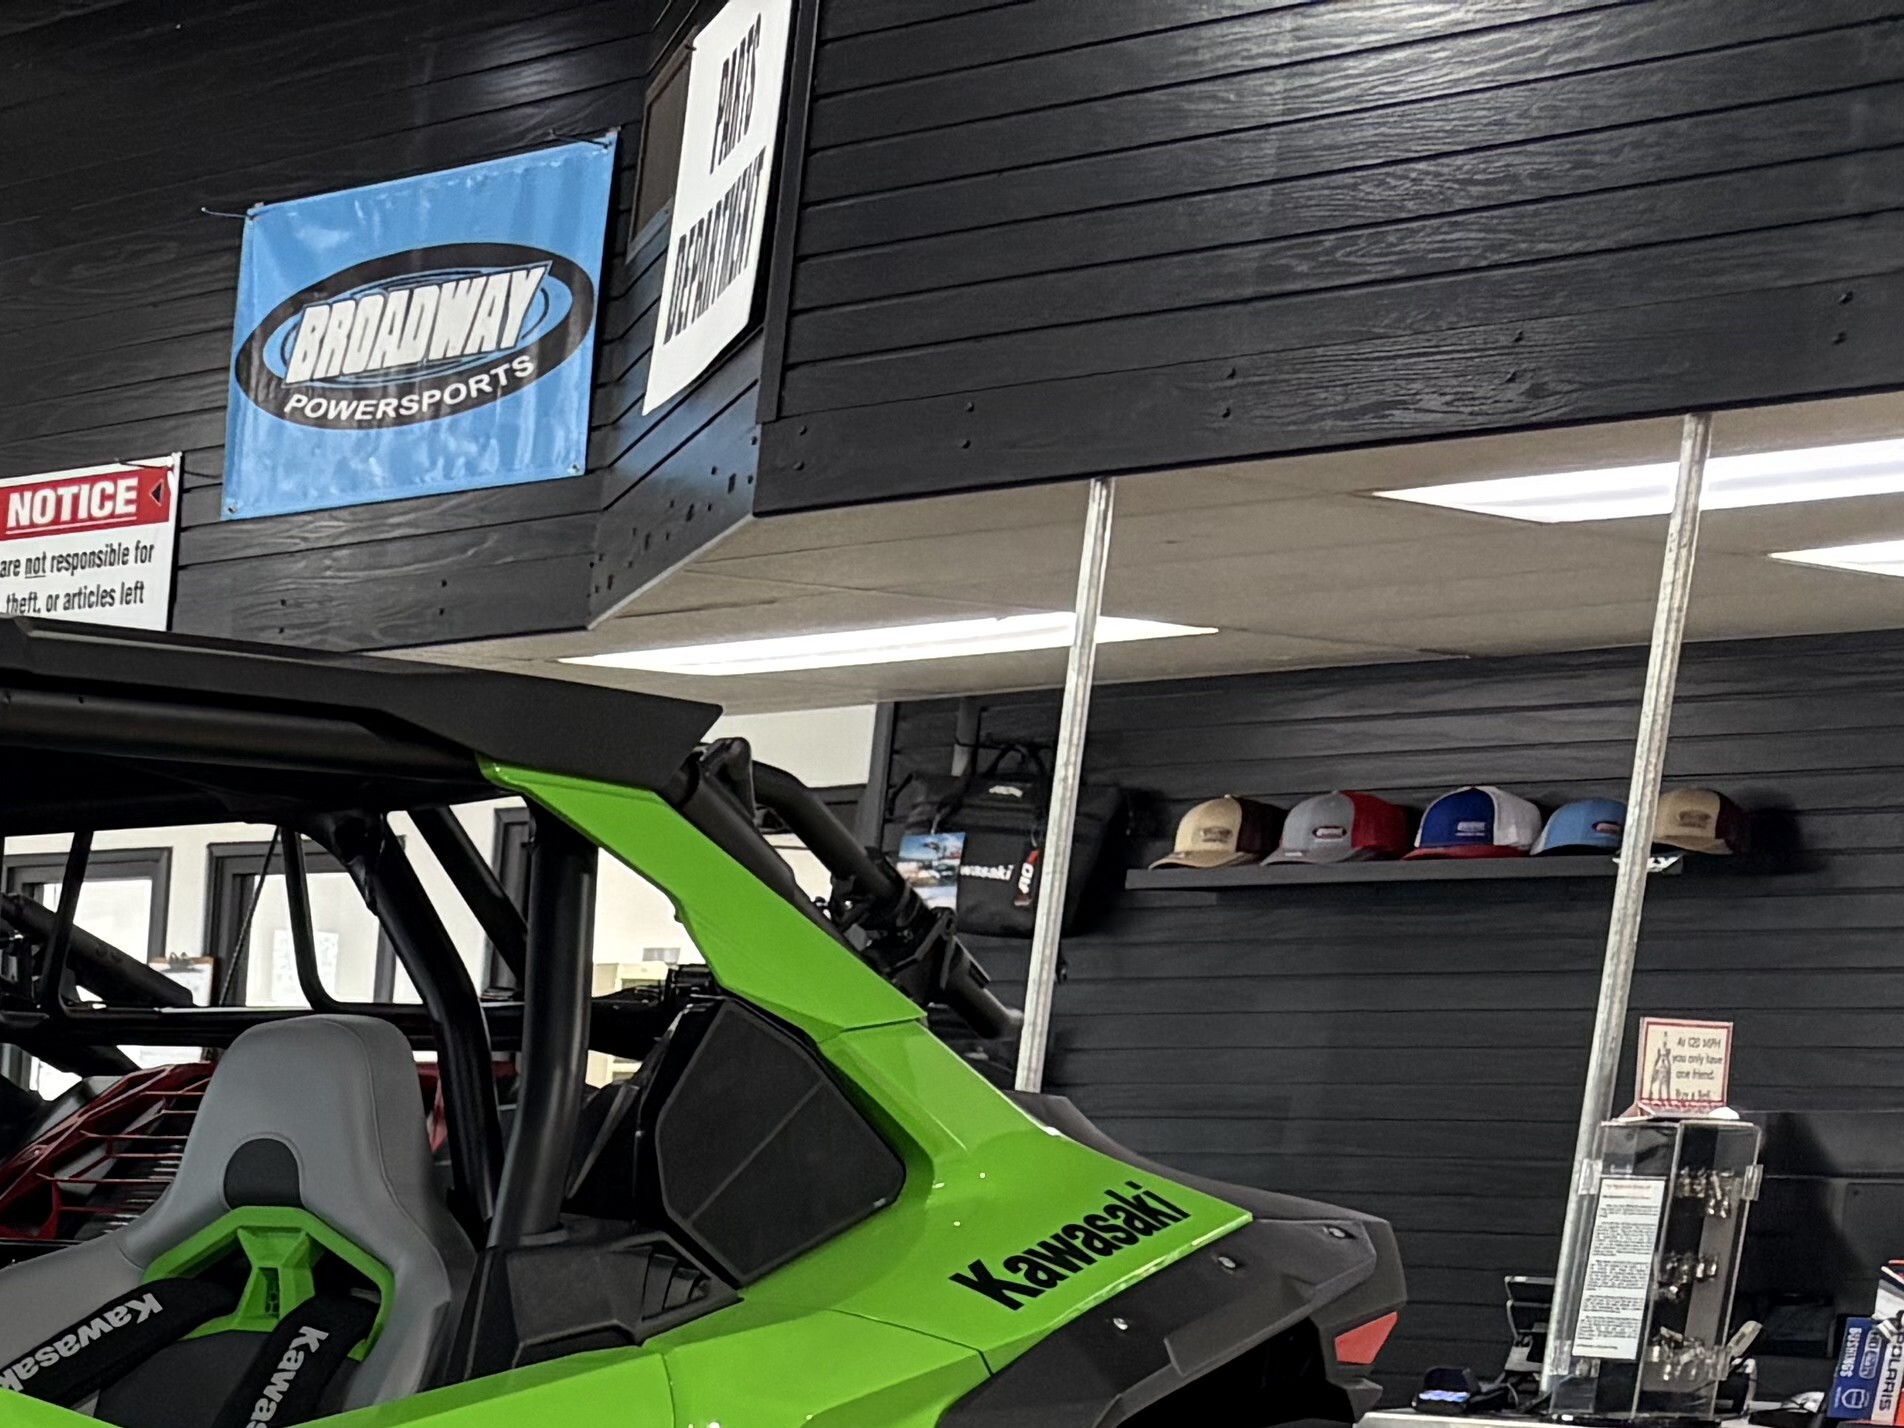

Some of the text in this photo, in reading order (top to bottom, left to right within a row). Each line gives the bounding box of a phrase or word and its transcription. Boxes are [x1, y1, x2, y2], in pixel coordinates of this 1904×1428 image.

[710, 12, 762, 175] PARTS
[663, 145, 767, 346] DEPARTMENT
[284, 264, 548, 386] BROADWAY
[283, 354, 535, 421] POWERSPORTS
[5, 476, 140, 530] NOTICE
[24, 551, 47, 579] not
[49, 542, 130, 577] responsible
[134, 540, 155, 564] for
[45, 593, 61, 612] or
[62, 584, 117, 611] articles
[119, 581, 145, 606] left
[959, 864, 1015, 881] wasaki
[949, 1180, 1192, 1311] Kawasaki
